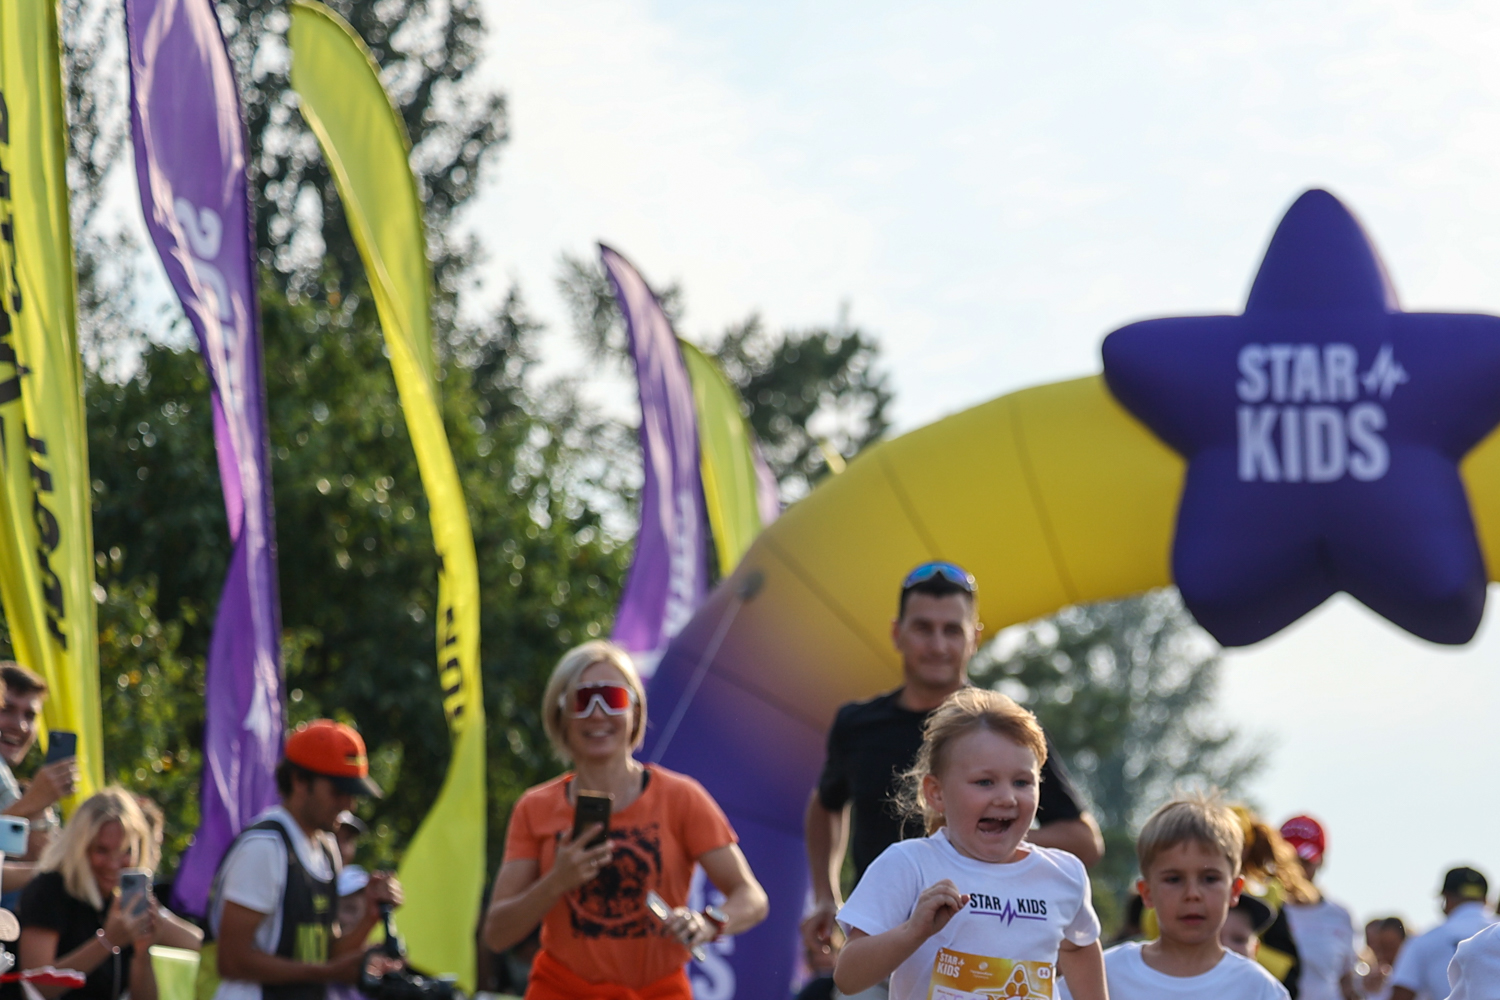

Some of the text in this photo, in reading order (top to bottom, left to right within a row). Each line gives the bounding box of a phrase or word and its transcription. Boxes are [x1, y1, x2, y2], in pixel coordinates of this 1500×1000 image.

[1236, 343, 1358, 402] STAR
[1236, 403, 1391, 483] KIDS
[970, 893, 1047, 915] STAR KIDS
[937, 962, 960, 978] KIDS
[939, 953, 958, 965] STAR
